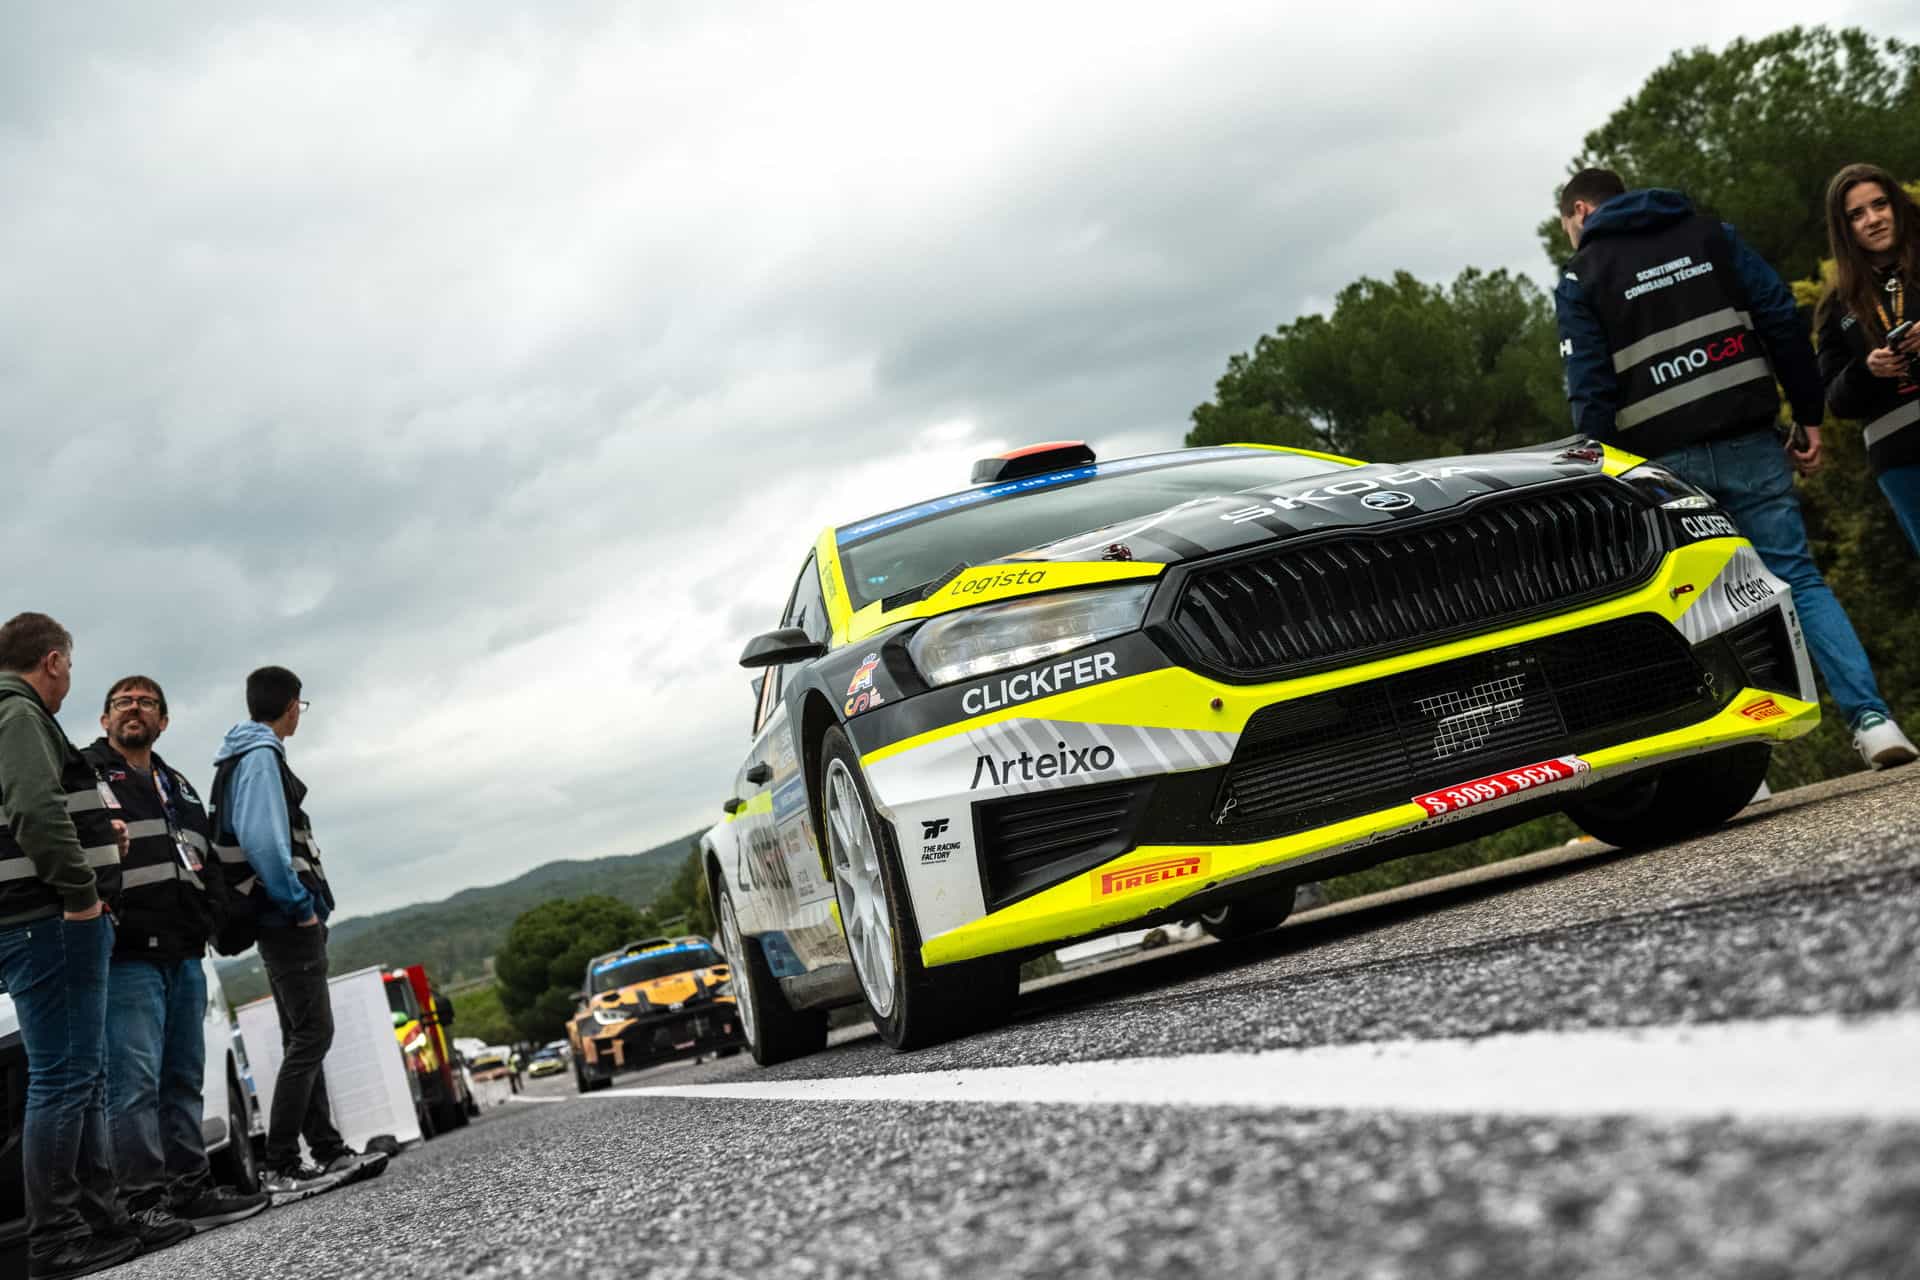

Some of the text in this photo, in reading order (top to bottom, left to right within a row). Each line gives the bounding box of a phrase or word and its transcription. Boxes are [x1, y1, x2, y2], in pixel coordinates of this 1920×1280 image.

[951, 569, 1046, 595] Logista
[1724, 572, 1775, 612] Arteixo
[961, 651, 1118, 715] CLICKFER
[969, 741, 1115, 790] Arteixo
[1425, 796, 1448, 815] S
[1447, 779, 1508, 808] 3091
[921, 851, 950, 861] FACTORY
[923, 845, 936, 853] THE
[1101, 857, 1200, 896] PIRELLI
